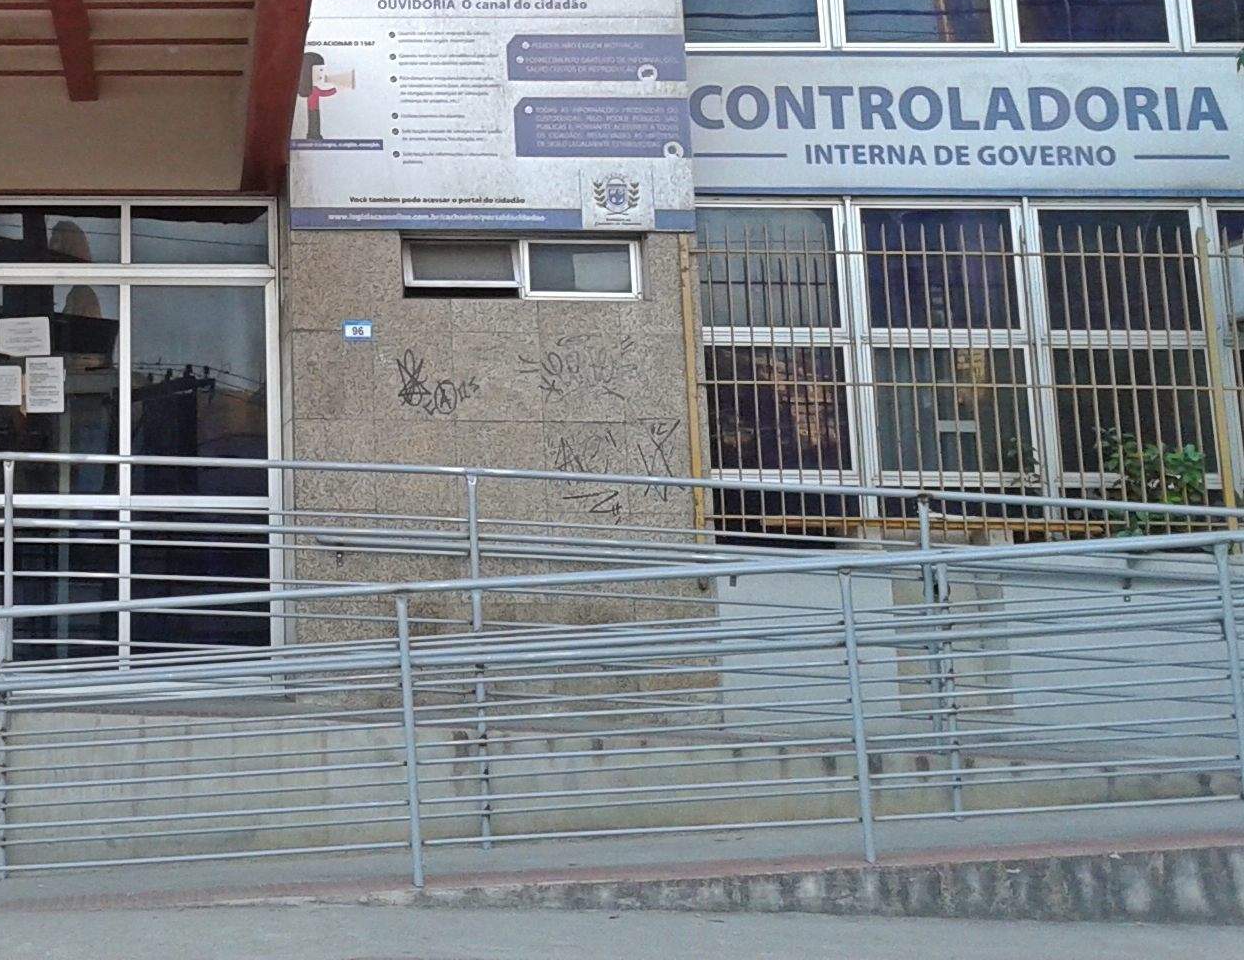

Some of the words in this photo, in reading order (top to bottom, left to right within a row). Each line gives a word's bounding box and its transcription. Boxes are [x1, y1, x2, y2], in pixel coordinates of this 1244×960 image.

[461, 0, 472, 10] O
[689, 83, 1229, 133] CONTROLADORIA
[804, 143, 928, 166] INTERNA
[934, 144, 970, 166] DE
[977, 144, 1117, 167] GOVERNO
[352, 326, 365, 336] 96
